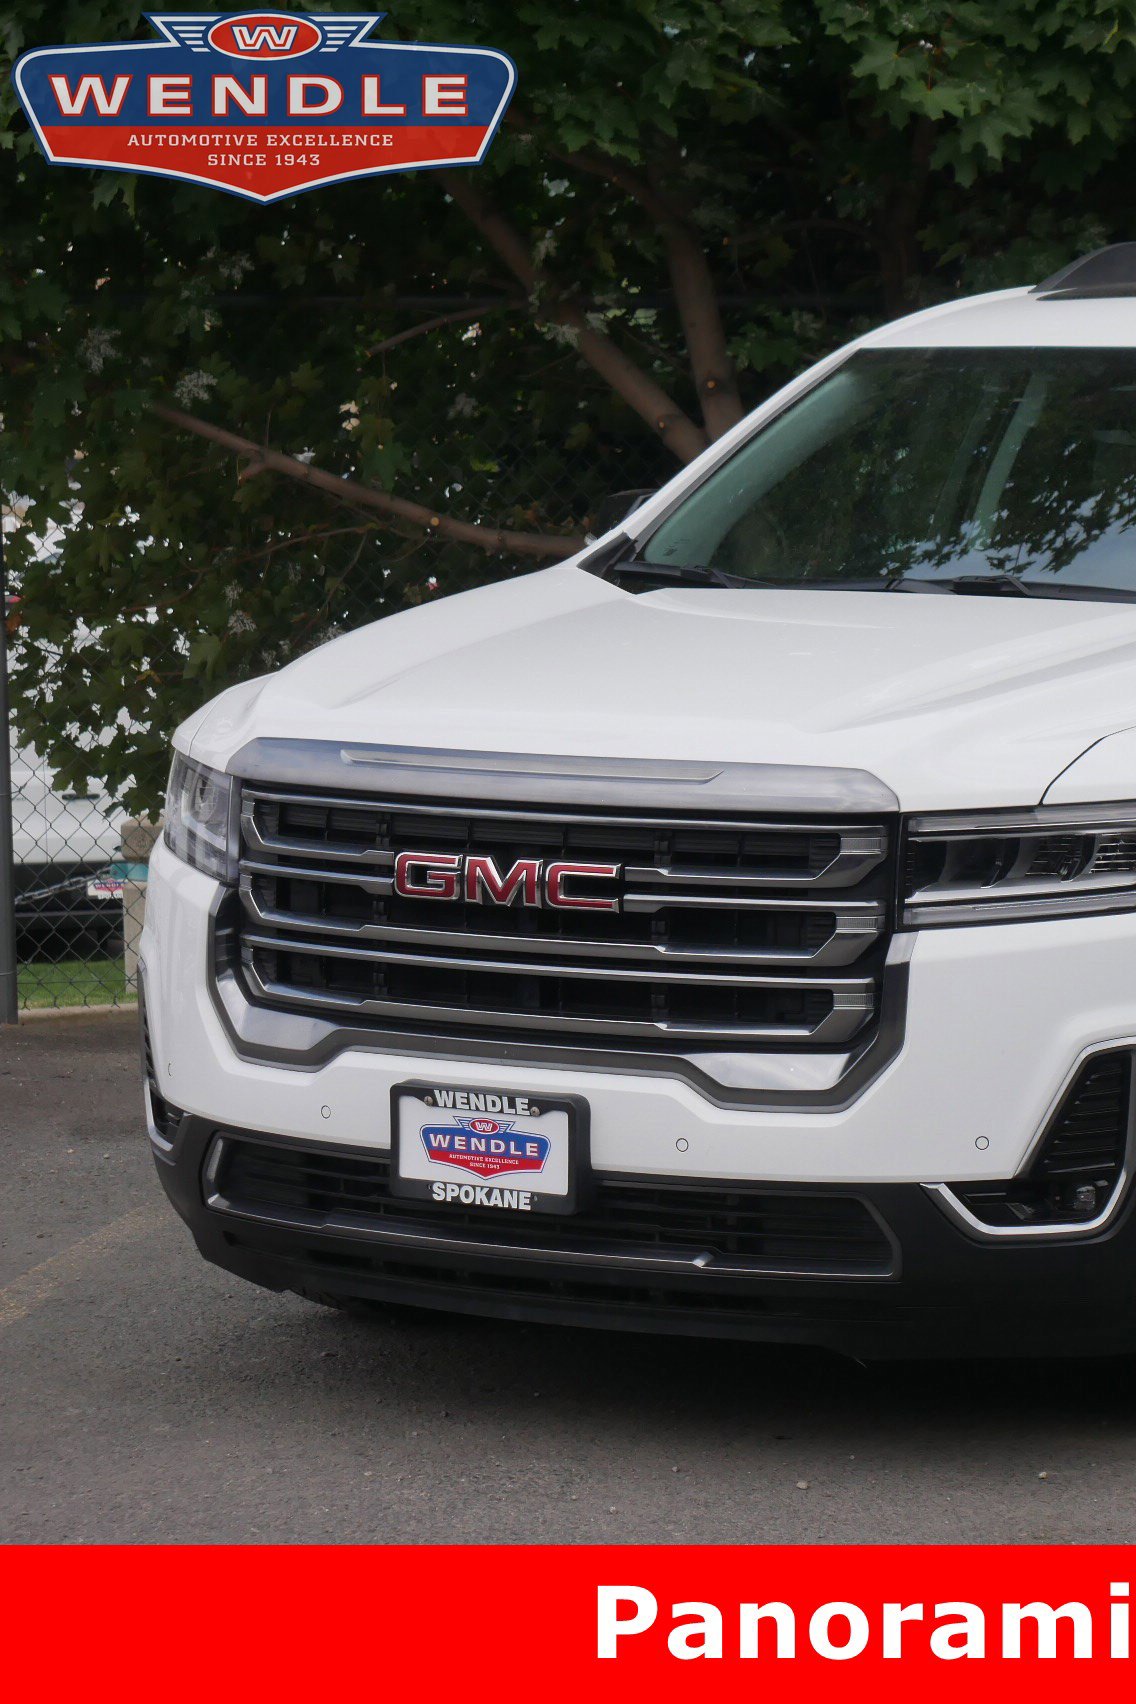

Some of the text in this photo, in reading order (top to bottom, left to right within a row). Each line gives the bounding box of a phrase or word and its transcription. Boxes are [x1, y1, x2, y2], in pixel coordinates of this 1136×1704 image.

[394, 851, 622, 914] GMC
[433, 1089, 532, 1116] WENDLE
[429, 1133, 539, 1157] WENDLE
[448, 1153, 520, 1165] AUTOMOTIVE EXCELLENCE
[432, 1181, 532, 1211] SPOKANE
